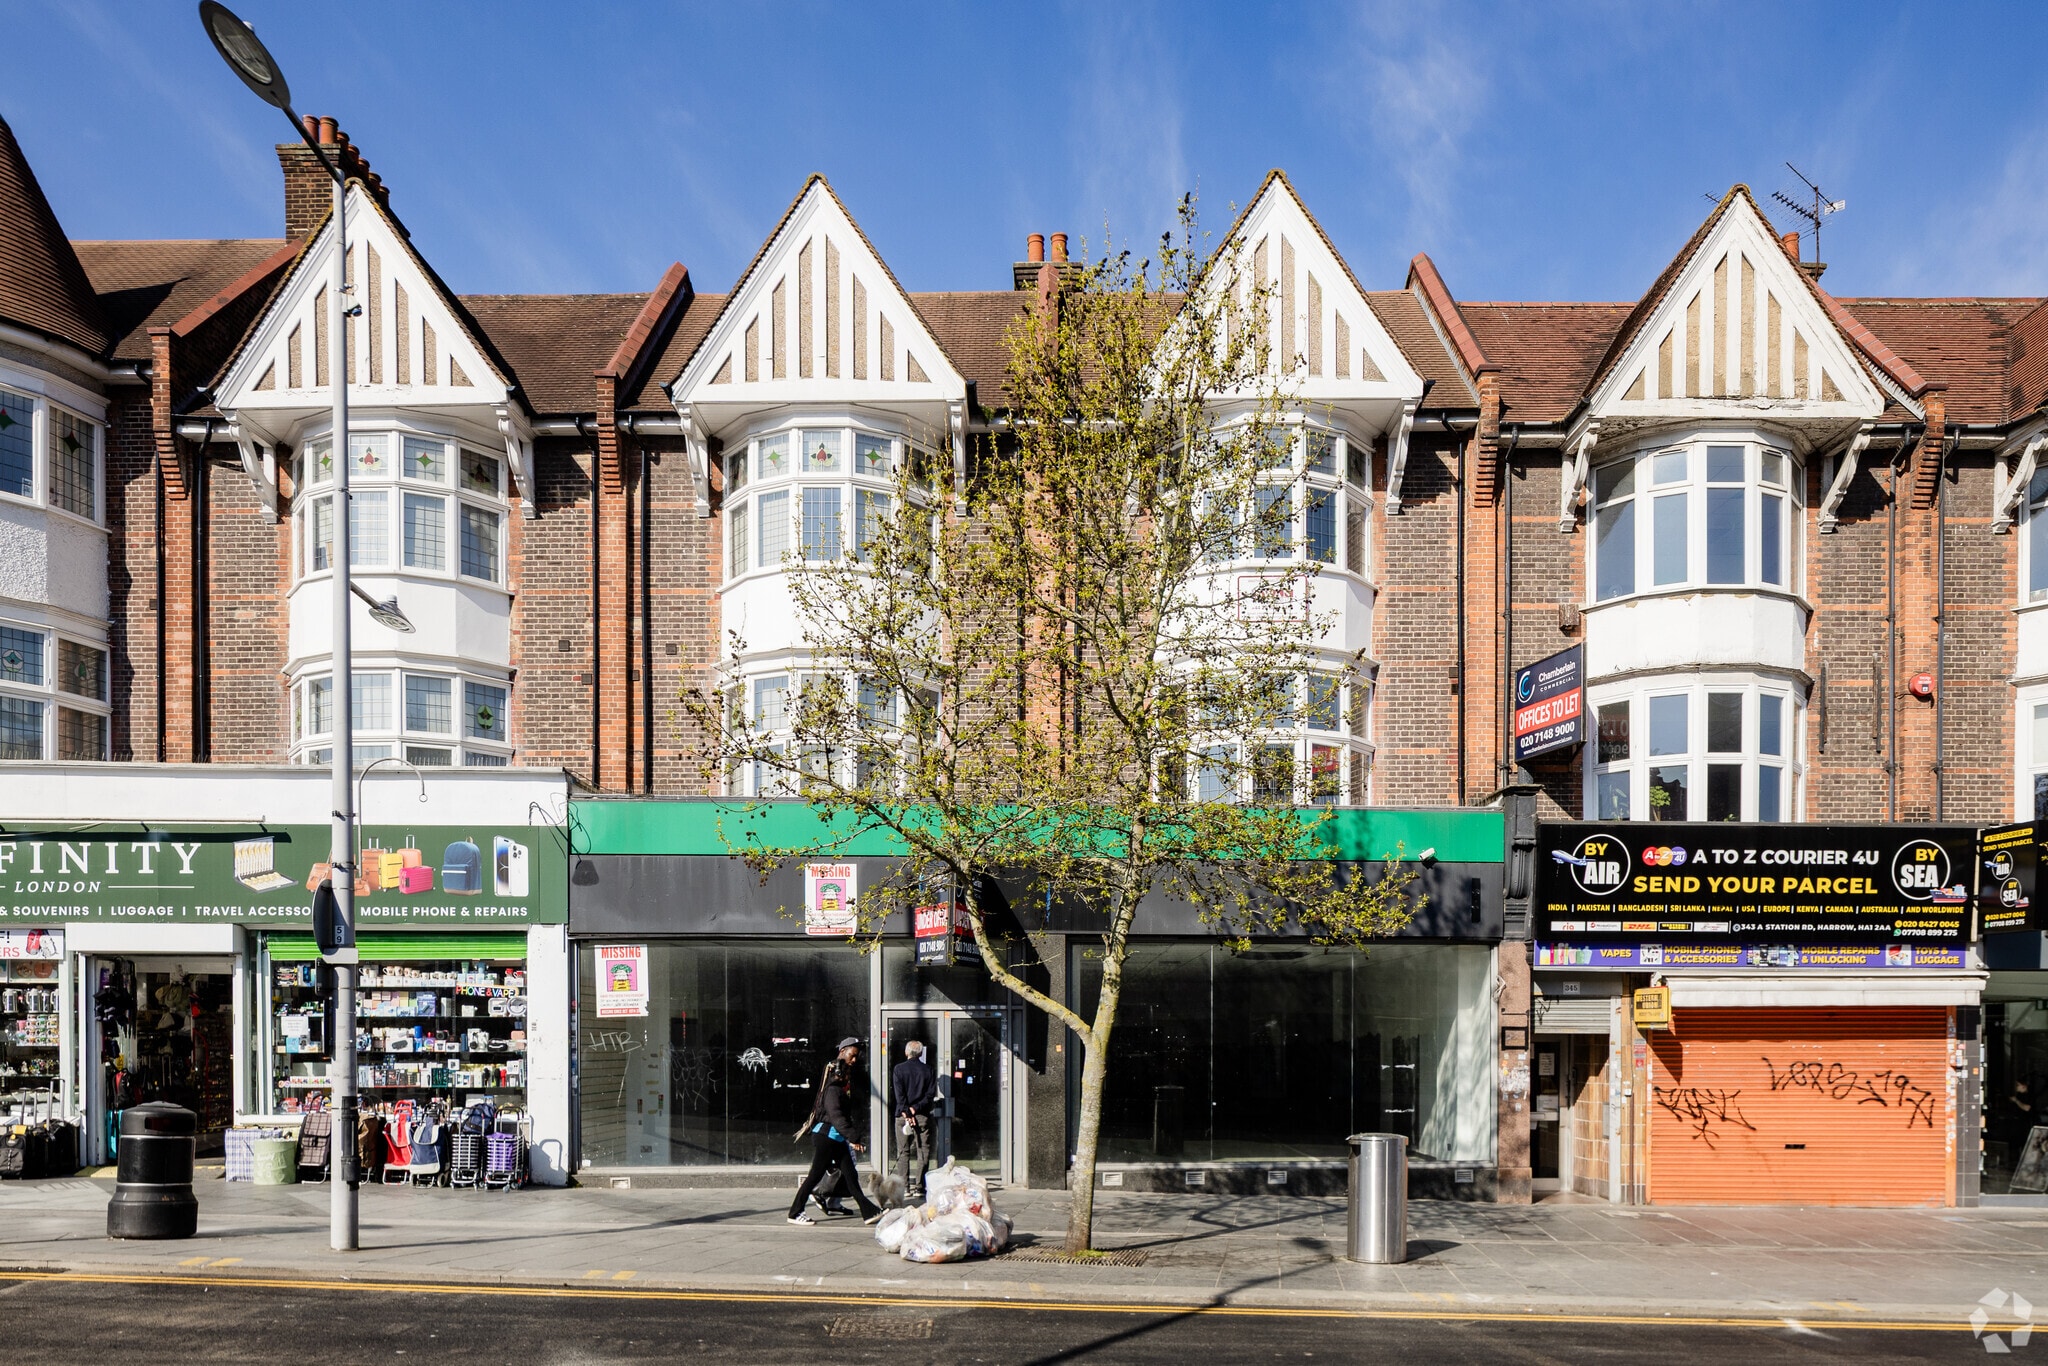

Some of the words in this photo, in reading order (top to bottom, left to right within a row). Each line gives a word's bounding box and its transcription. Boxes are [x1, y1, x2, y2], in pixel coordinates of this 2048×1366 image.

[1538, 661, 1576, 682] Chamberlain
[1540, 676, 1574, 692] COMMERCIAL
[1518, 703, 1551, 730] OFFICES
[1552, 698, 1563, 719] TO
[1565, 693, 1579, 715] LET
[1520, 735, 1533, 748] 020
[1535, 728, 1553, 743] 7148
[1555, 721, 1575, 737] 9000
[1584, 842, 1608, 856] BY
[1982, 844, 1997, 852] SEND
[1998, 841, 2012, 849] YOUR
[2013, 837, 2034, 847] PARCEL
[1645, 851, 1654, 859] A
[1692, 849, 1708, 864] A
[1712, 849, 1739, 864] TO
[1743, 849, 1757, 864] Z
[1761, 850, 1848, 865] COURIER
[1852, 850, 1879, 865] 4U
[1915, 848, 1939, 861] BY
[1583, 861, 1620, 885] AIR
[1996, 862, 2010, 876] AIR
[1901, 864, 1939, 887] SEA
[14, 881, 102, 892] LONDON
[1633, 876, 1700, 893] SEND
[1707, 876, 1775, 893] YOUR
[1783, 877, 1878, 894] PARCEL
[2003, 889, 2017, 902] SEA
[12, 906, 90, 916] SOUVENIRS
[111, 906, 174, 916] LUGGAGE
[195, 906, 244, 916] TRAVEL
[248, 906, 311, 916] ACCESSO
[360, 906, 409, 917] MOBILE
[413, 906, 457, 917] PHONE
[460, 906, 470, 917] &
[475, 906, 528, 917] REPAIRS
[1577, 904, 1610, 912] PAKISTAN
[1618, 904, 1664, 912] BANGLADESH
[1670, 904, 1682, 912] SRI
[917, 910, 934, 930] UNDER
[0, 947, 20, 957] RS
[601, 946, 641, 959] MISSING
[1600, 949, 1632, 958] VAPES
[1664, 945, 1700, 955] MOBILE
[1703, 945, 1742, 955] PHONES
[1801, 946, 1838, 955] MOBILE
[1841, 946, 1880, 955] REPAIRS
[1915, 946, 1939, 955] TOYS
[1941, 946, 1948, 955] &
[1664, 955, 1671, 963] &
[1673, 955, 1738, 964] ACCESSORIES
[1801, 955, 1808, 964] &
[1811, 955, 1867, 964] UNLOCKING
[1915, 955, 1960, 965] LUGGAGE
[455, 985, 486, 997] PHONE
